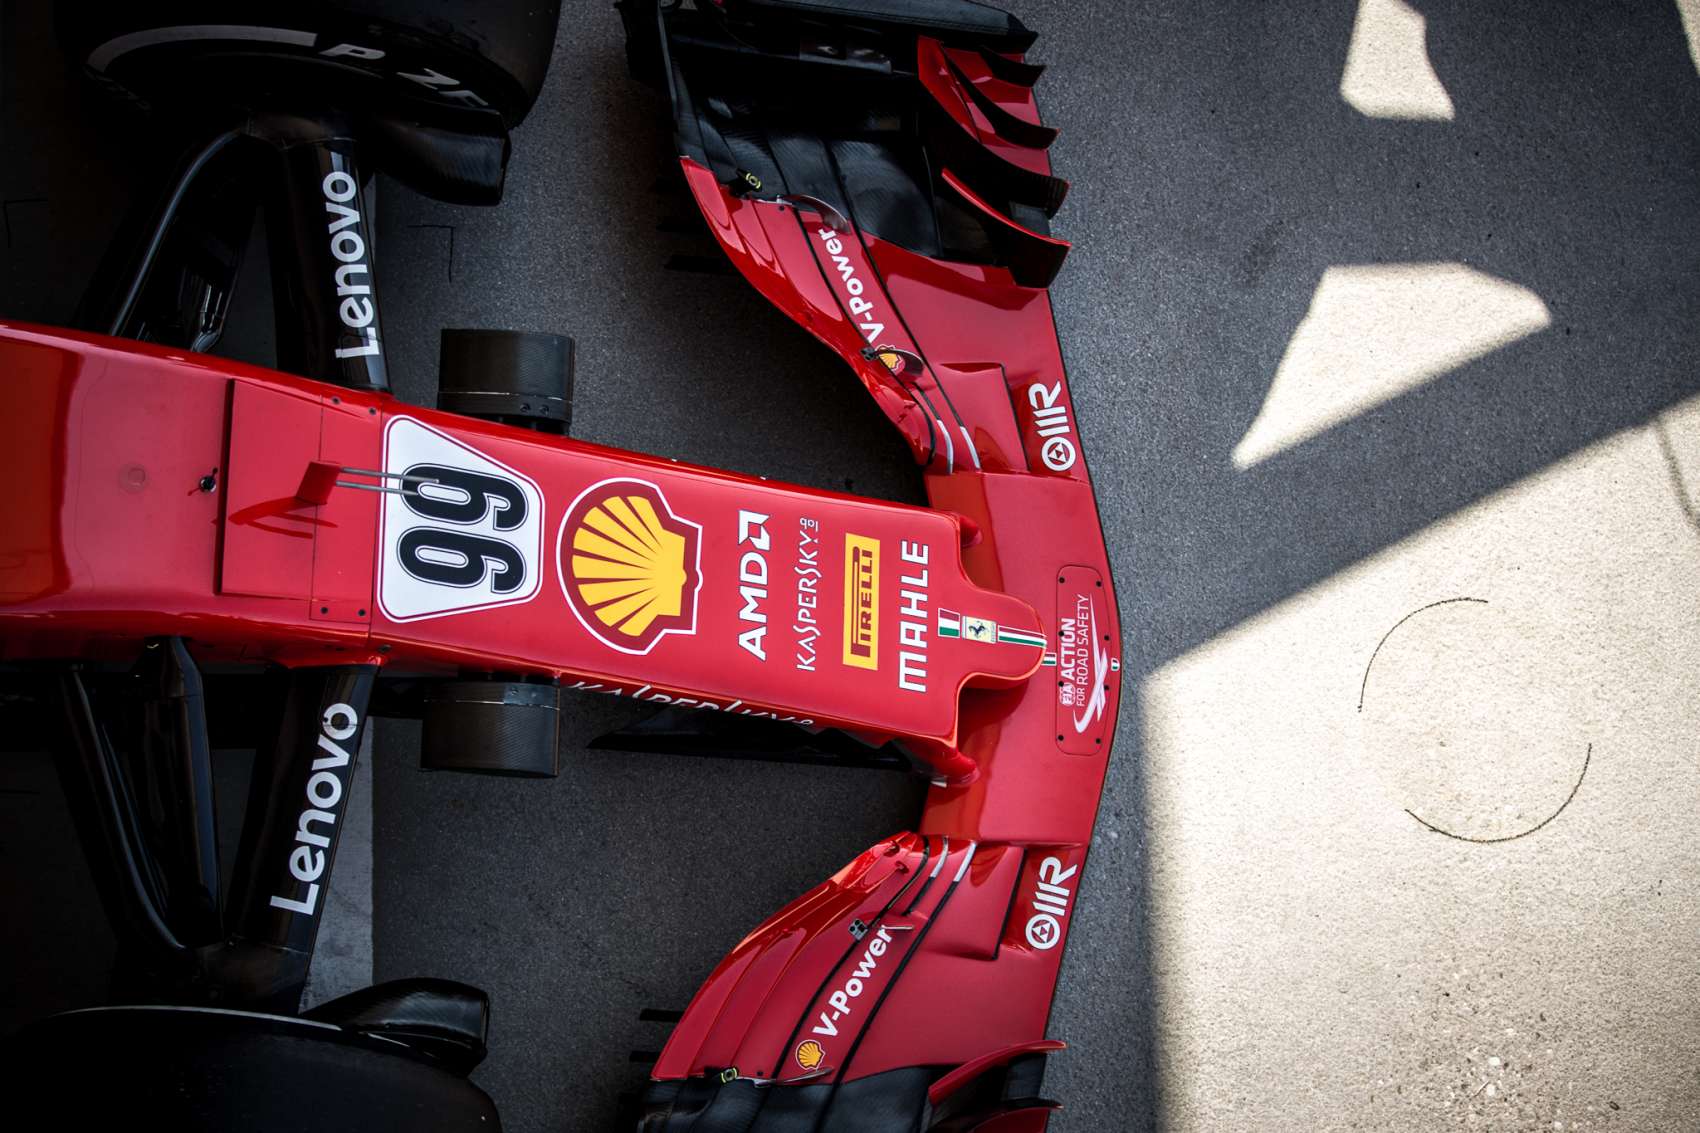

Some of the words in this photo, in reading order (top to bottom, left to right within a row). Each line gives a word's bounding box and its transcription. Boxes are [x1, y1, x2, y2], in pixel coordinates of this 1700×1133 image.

[322, 171, 380, 358] Lenovo
[818, 228, 888, 347] V-Power
[397, 463, 529, 594] 99
[738, 550, 769, 661] AMD
[794, 529, 822, 672] KASPERSKY
[850, 546, 873, 658] PIRELLI
[898, 540, 929, 693] MAHLE
[1060, 617, 1076, 681] ACTION
[1076, 594, 1090, 646] SAFETY
[1076, 647, 1089, 686] ROAD
[1076, 687, 1086, 707] FOR
[270, 702, 358, 915] Lenovo
[812, 924, 892, 1038] V-Power
